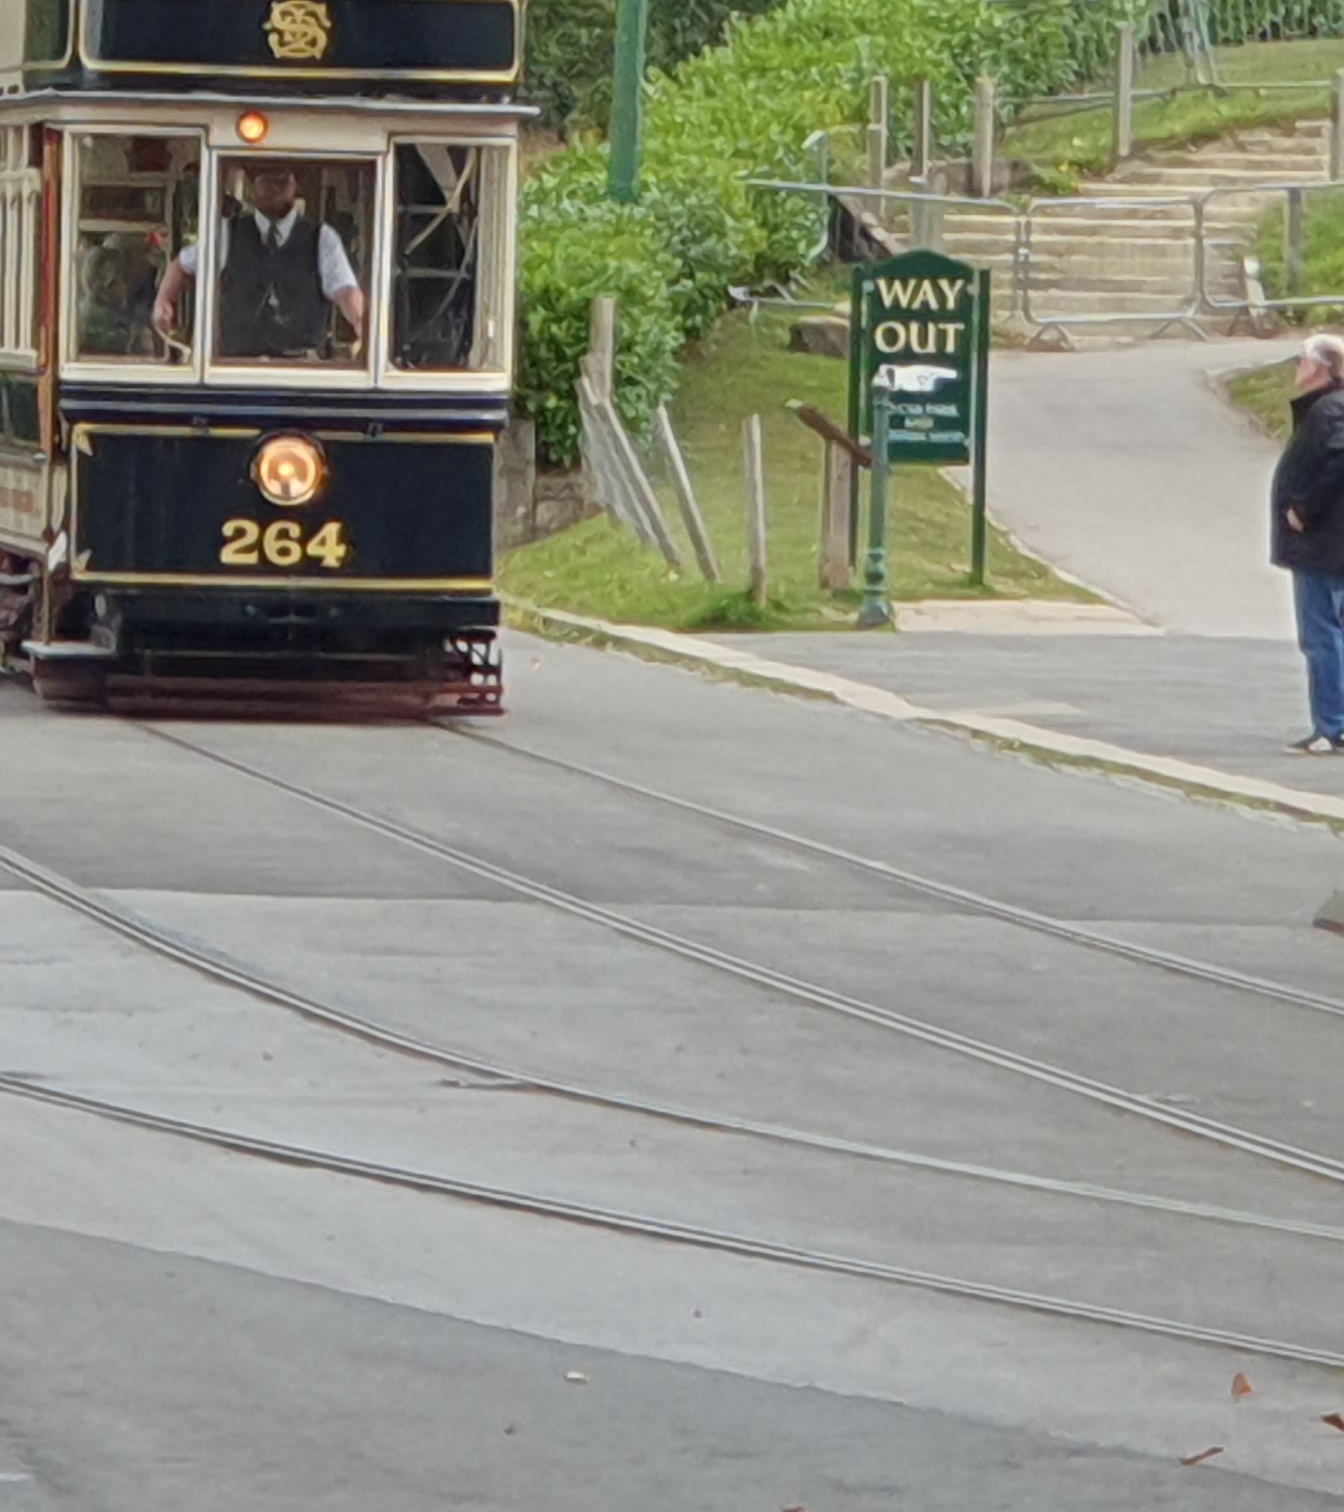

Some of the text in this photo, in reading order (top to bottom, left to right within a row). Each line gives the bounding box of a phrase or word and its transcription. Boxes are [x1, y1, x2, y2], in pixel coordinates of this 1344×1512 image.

[877, 279, 964, 311] WAY
[874, 321, 965, 354] OUT
[220, 518, 348, 568] 264
